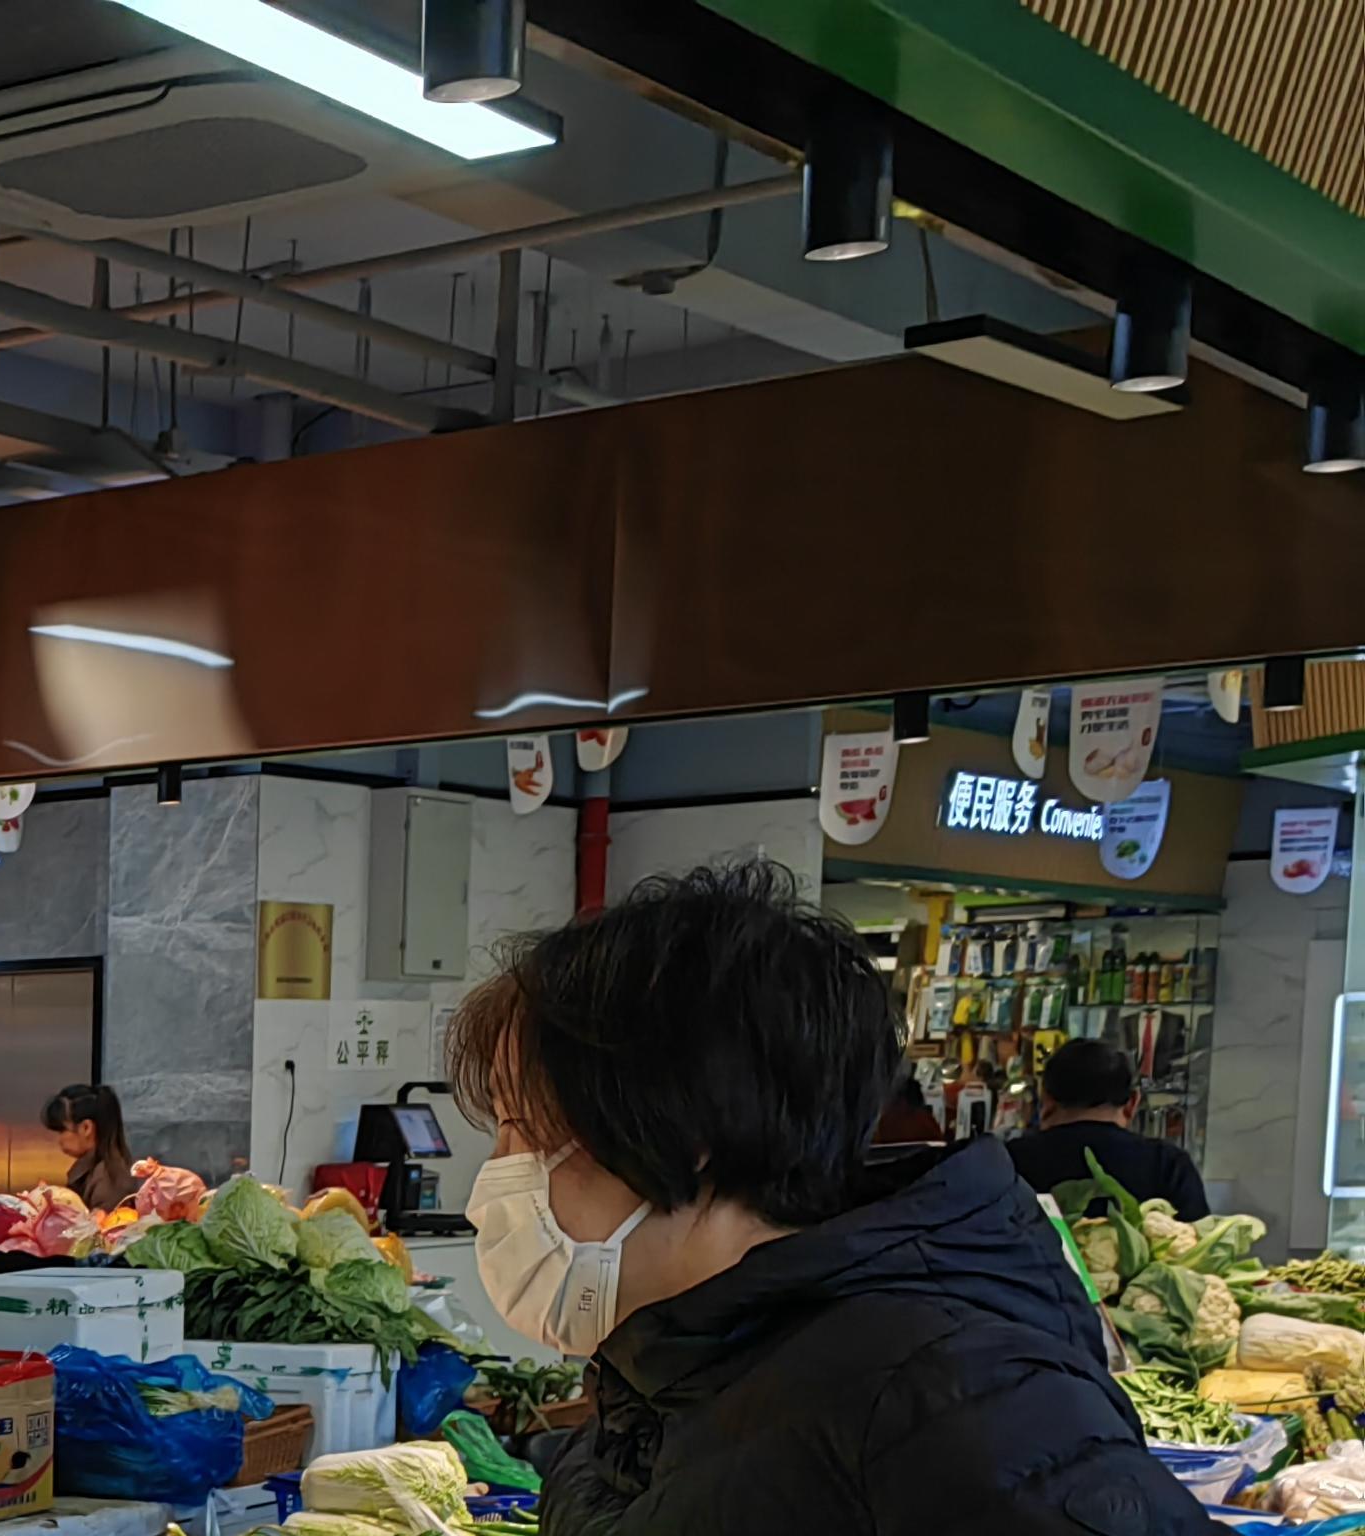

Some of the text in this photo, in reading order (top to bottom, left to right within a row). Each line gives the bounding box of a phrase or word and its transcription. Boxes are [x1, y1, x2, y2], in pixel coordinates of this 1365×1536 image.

[949, 771, 1039, 834] 便民服务
[1040, 799, 1105, 841] Convenie
[336, 1040, 390, 1066] 公平秤
